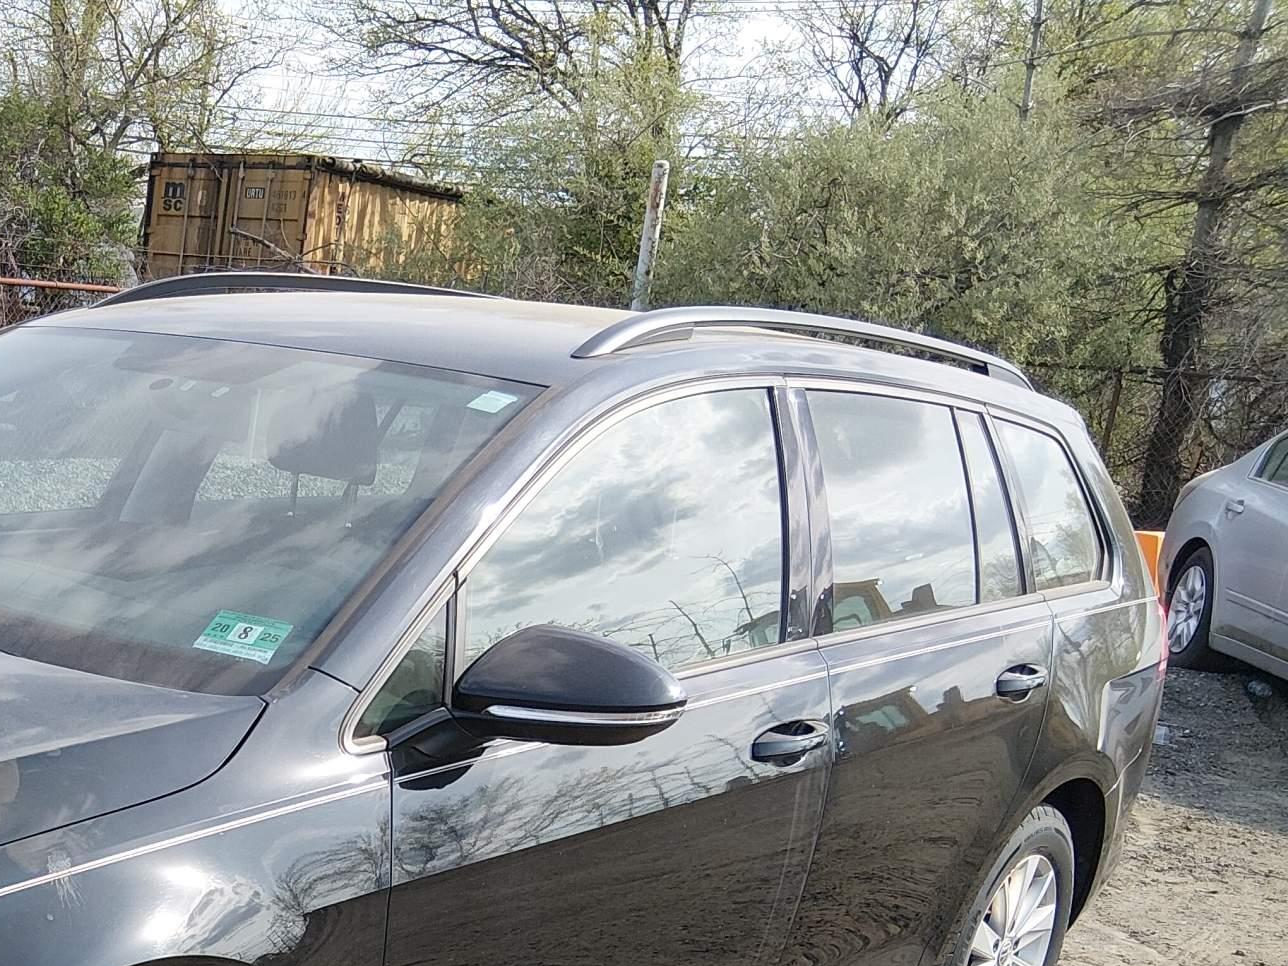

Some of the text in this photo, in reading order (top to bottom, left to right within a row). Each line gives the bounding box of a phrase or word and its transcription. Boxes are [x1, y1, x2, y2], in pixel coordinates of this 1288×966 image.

[211, 622, 281, 643] 20 8 25
